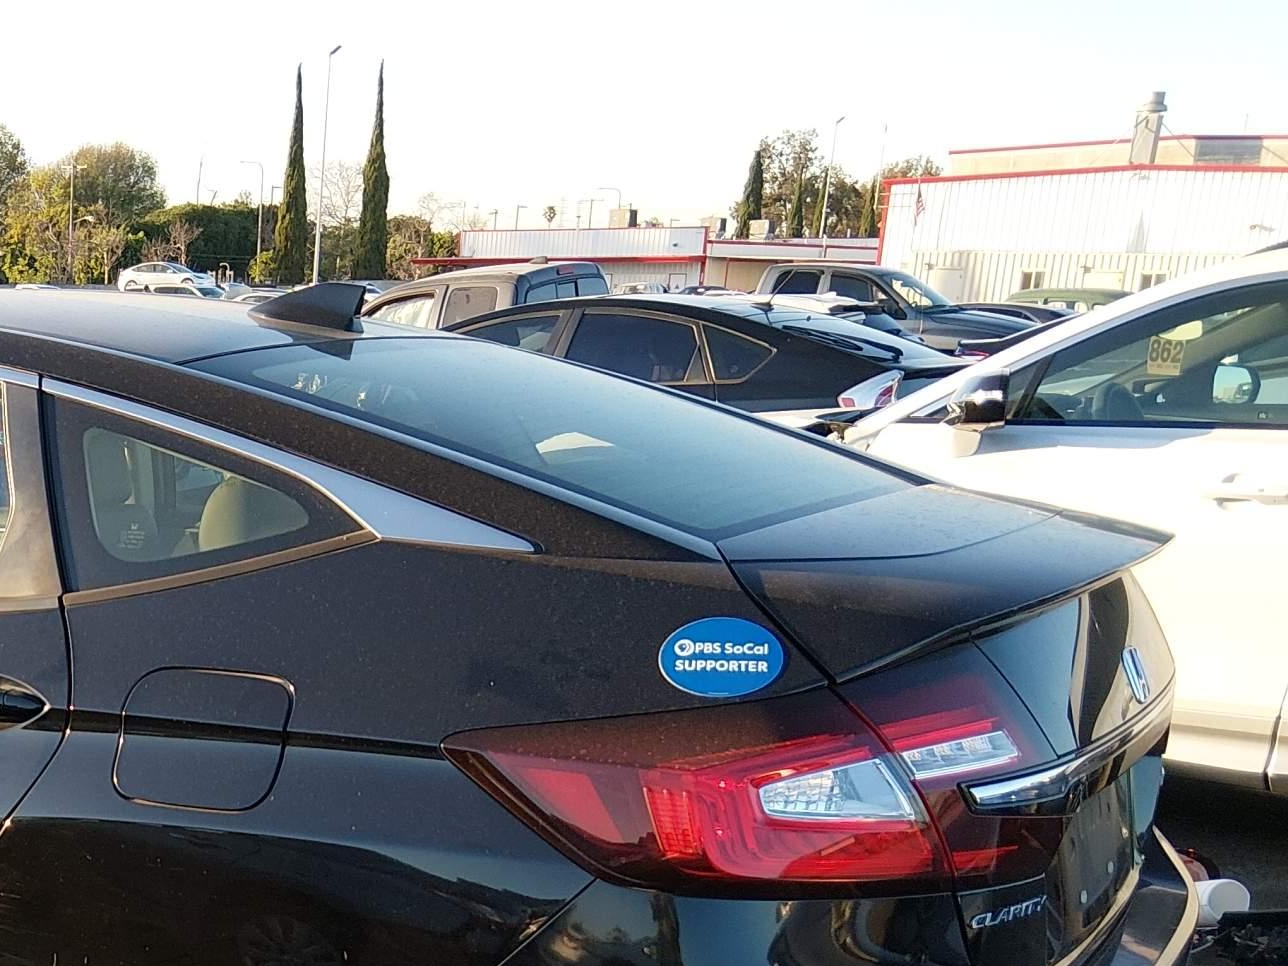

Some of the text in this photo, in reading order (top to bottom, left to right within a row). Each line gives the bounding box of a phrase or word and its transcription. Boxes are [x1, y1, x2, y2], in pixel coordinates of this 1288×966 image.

[1149, 339, 1185, 363] 862
[694, 642, 769, 655] PBS SoCal
[674, 659, 769, 672] SUPPORTER
[972, 895, 1048, 929] CLARITY
